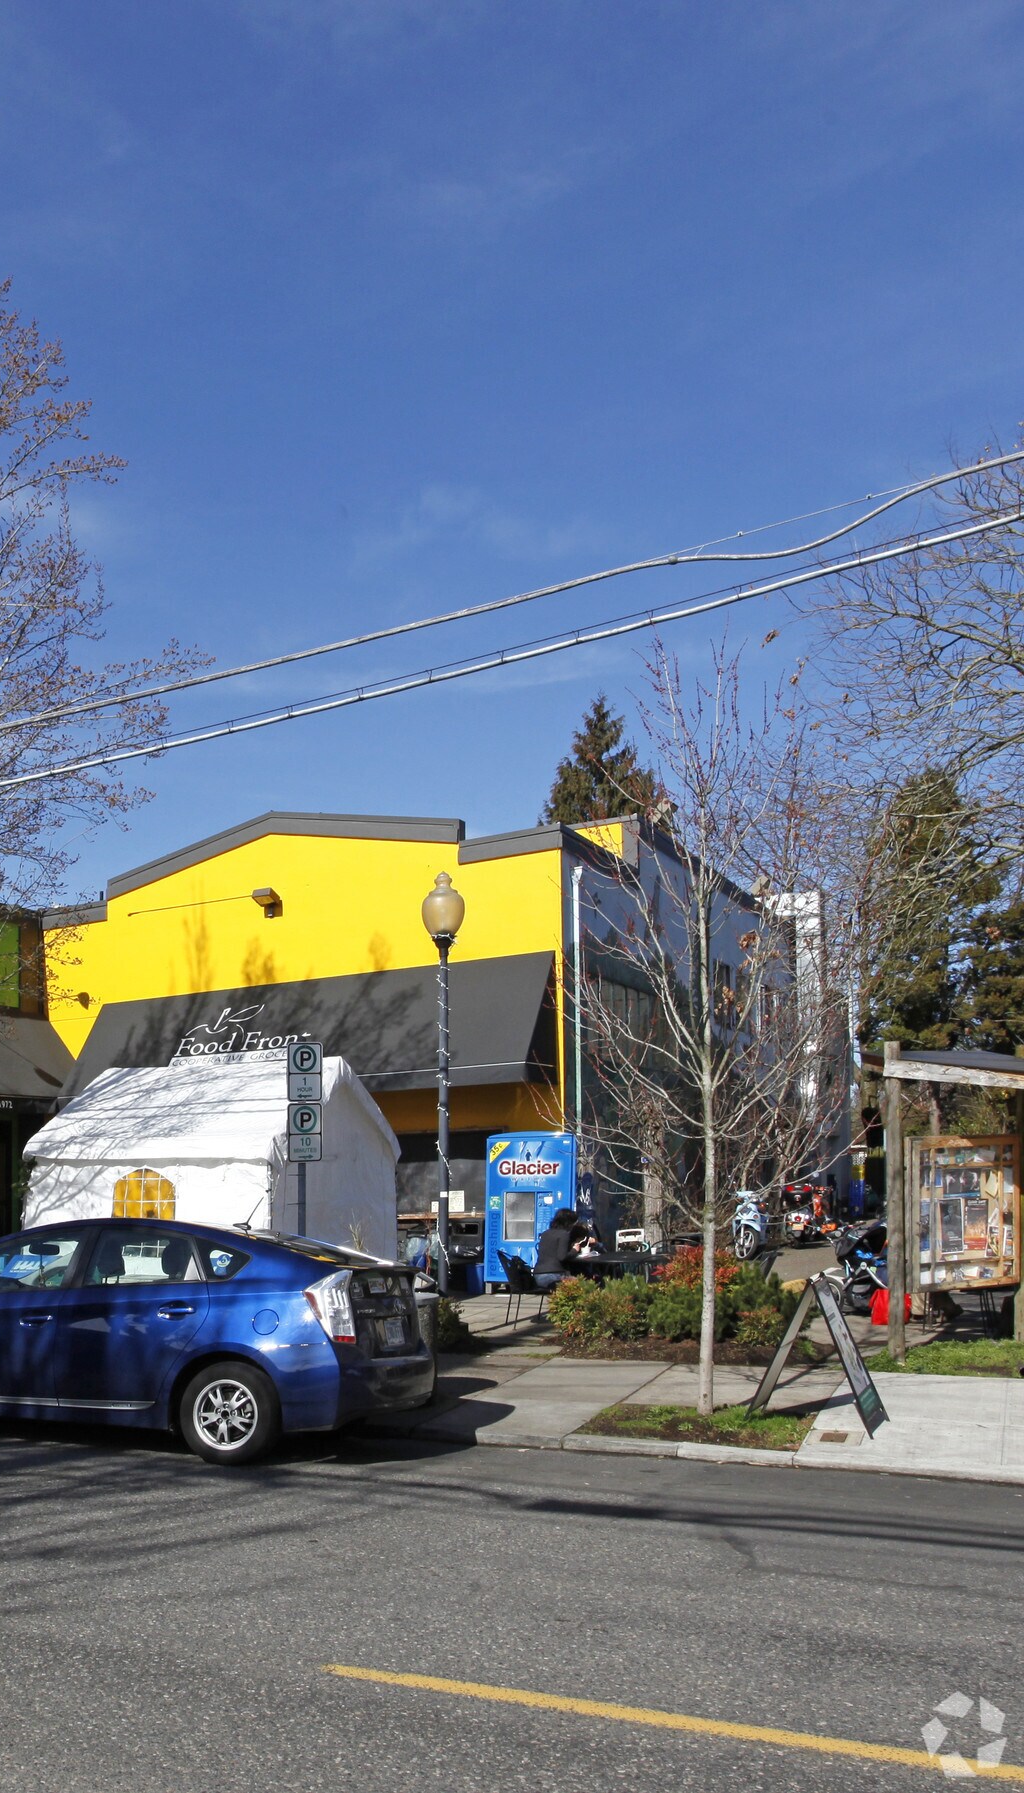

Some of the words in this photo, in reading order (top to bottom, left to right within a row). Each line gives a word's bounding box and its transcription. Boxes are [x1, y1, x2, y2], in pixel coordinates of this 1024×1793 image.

[174, 1032, 239, 1057] Food
[172, 1054, 245, 1067] COOPERATIVE
[250, 1051, 288, 1061] GROCE
[300, 1051, 312, 1067] P
[302, 1077, 307, 1086] 1
[300, 1112, 312, 1128] P
[300, 1137, 311, 1146] 10
[499, 1160, 560, 1176] Glacier
[489, 1211, 501, 1277] refreshing
